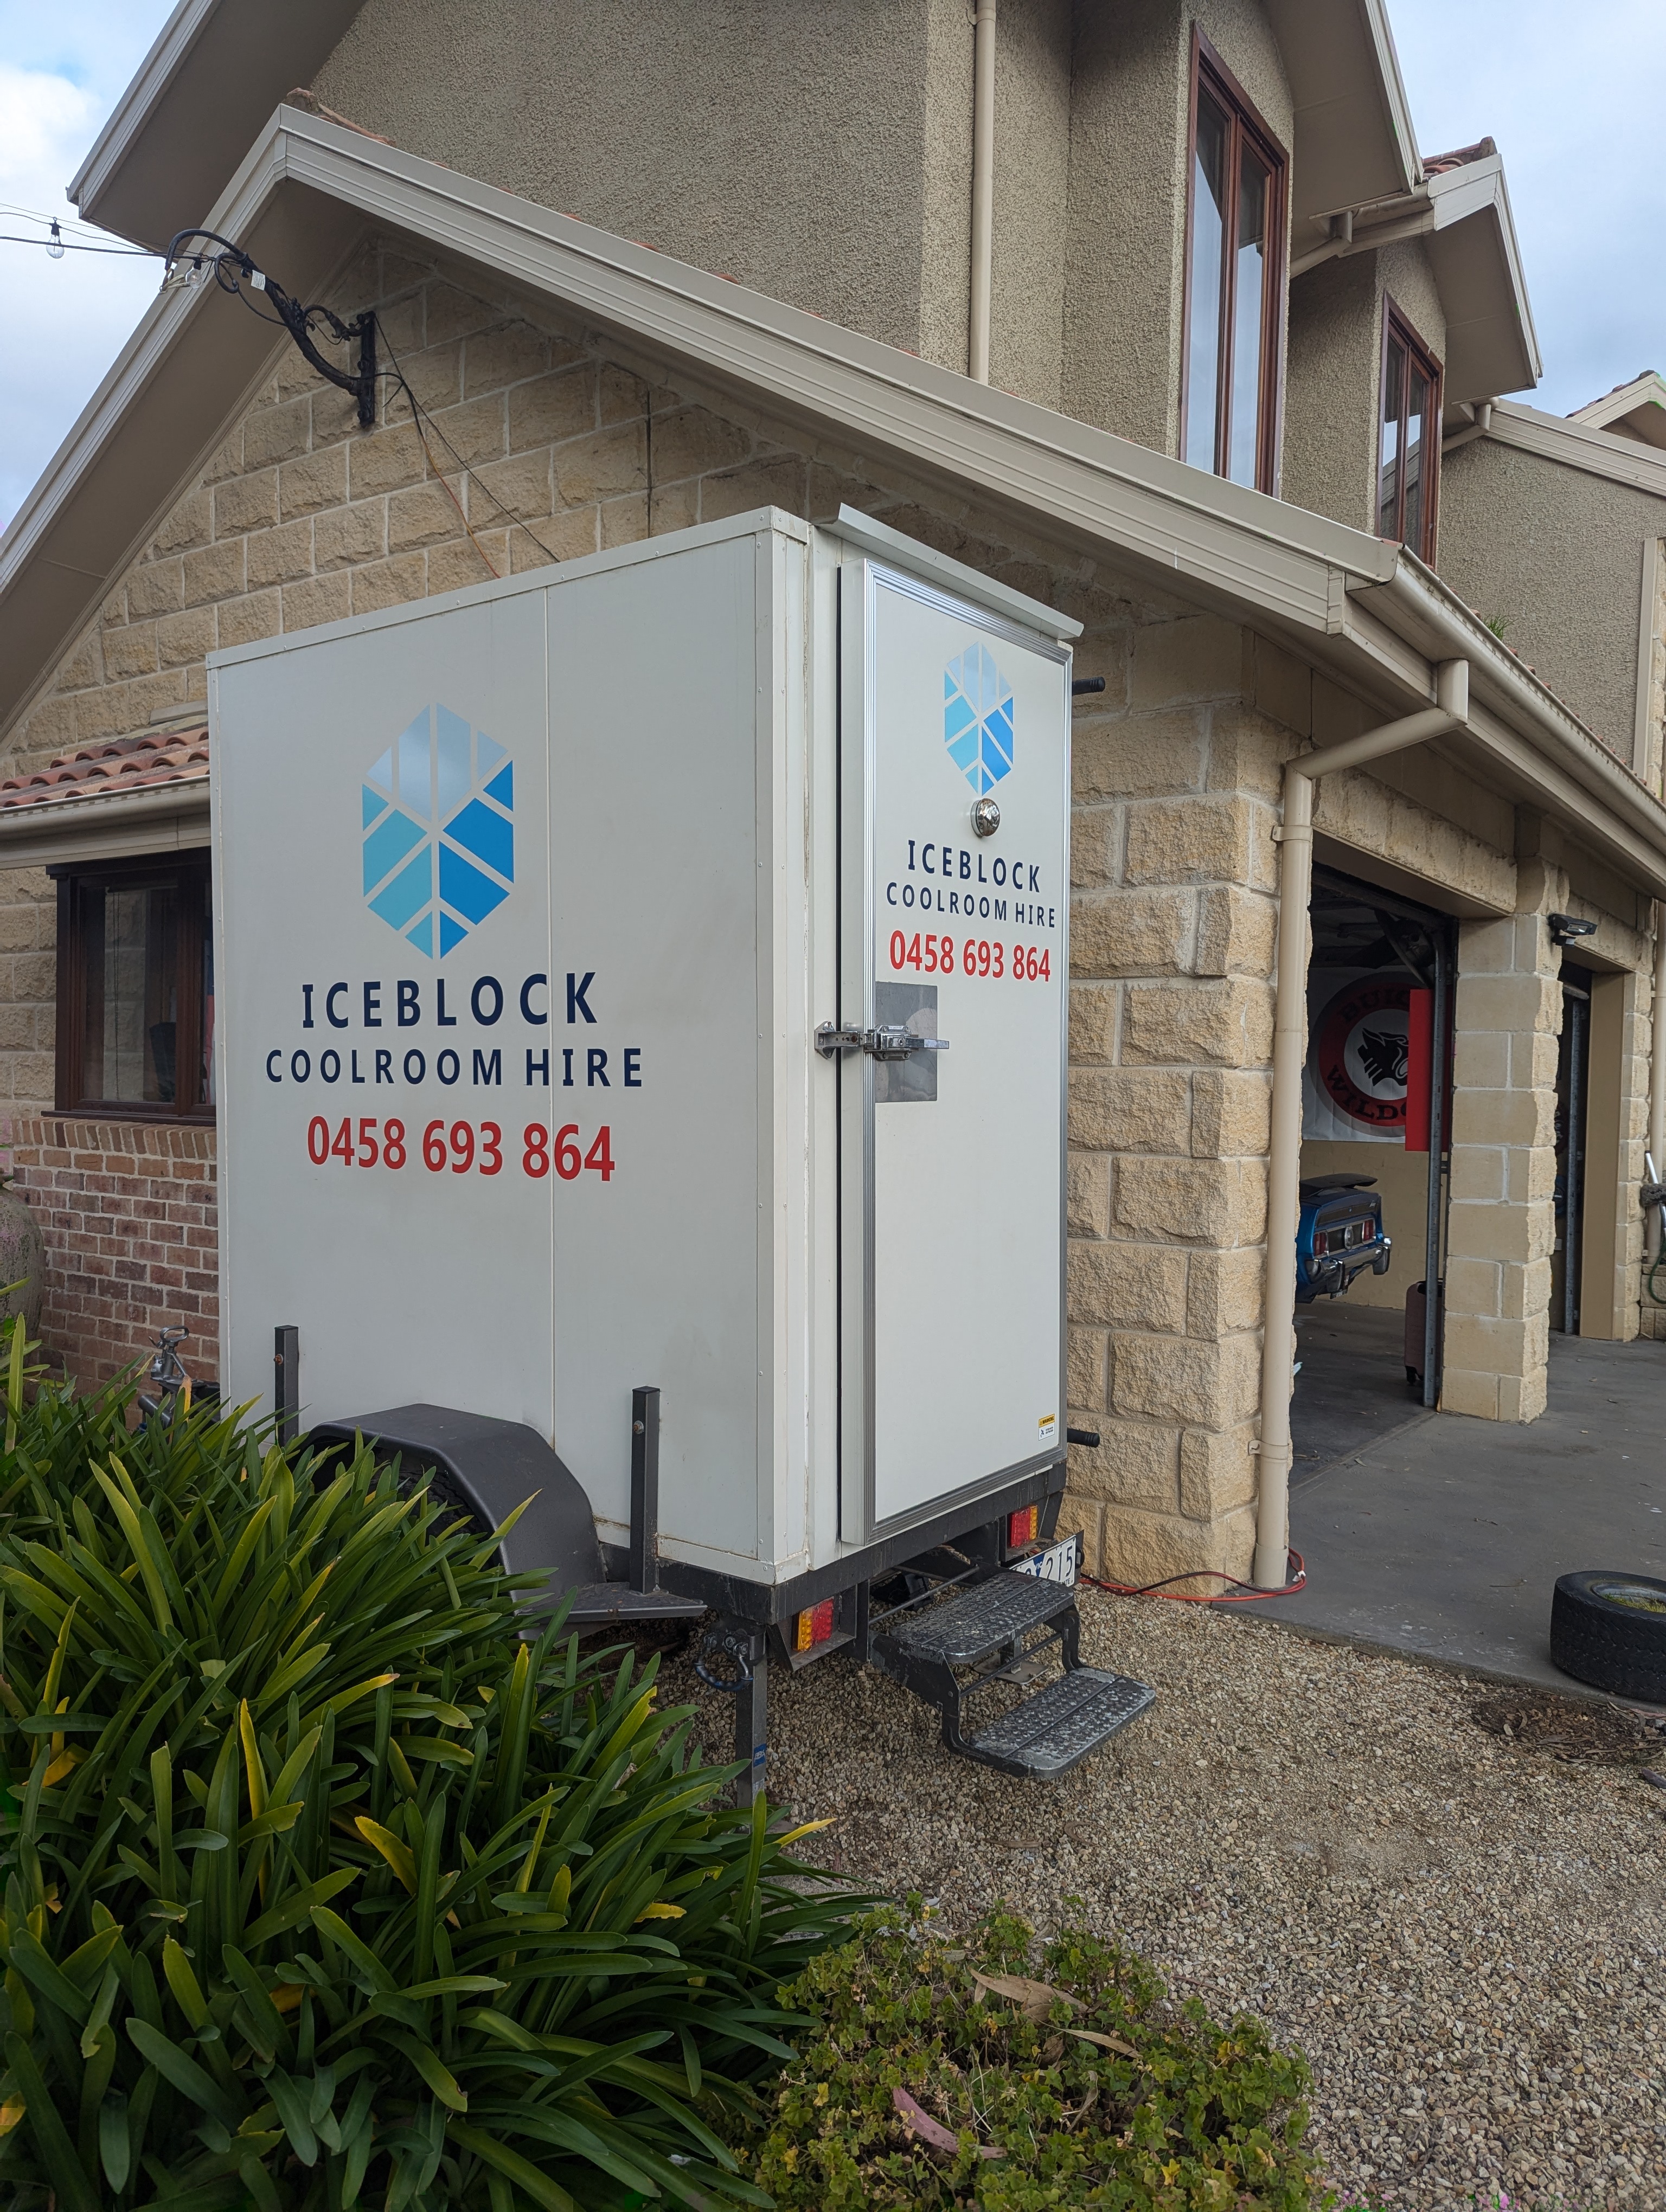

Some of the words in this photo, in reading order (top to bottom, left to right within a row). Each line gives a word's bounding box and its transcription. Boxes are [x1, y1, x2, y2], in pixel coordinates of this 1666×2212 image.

[908, 840, 1040, 893] ICEBLOCK
[886, 882, 1007, 921] COOLROOM
[1015, 902, 1055, 928] HIRE
[889, 930, 954, 974] 0458
[963, 938, 1004, 979] 693
[1013, 944, 1050, 982] 864
[302, 972, 598, 1028] ICEBLOCK
[266, 1049, 502, 1085] COOLROOM
[526, 1048, 642, 1087] HIRE
[307, 1116, 406, 1169] 0458
[422, 1120, 503, 1176] 693
[522, 1123, 615, 1182] 864
